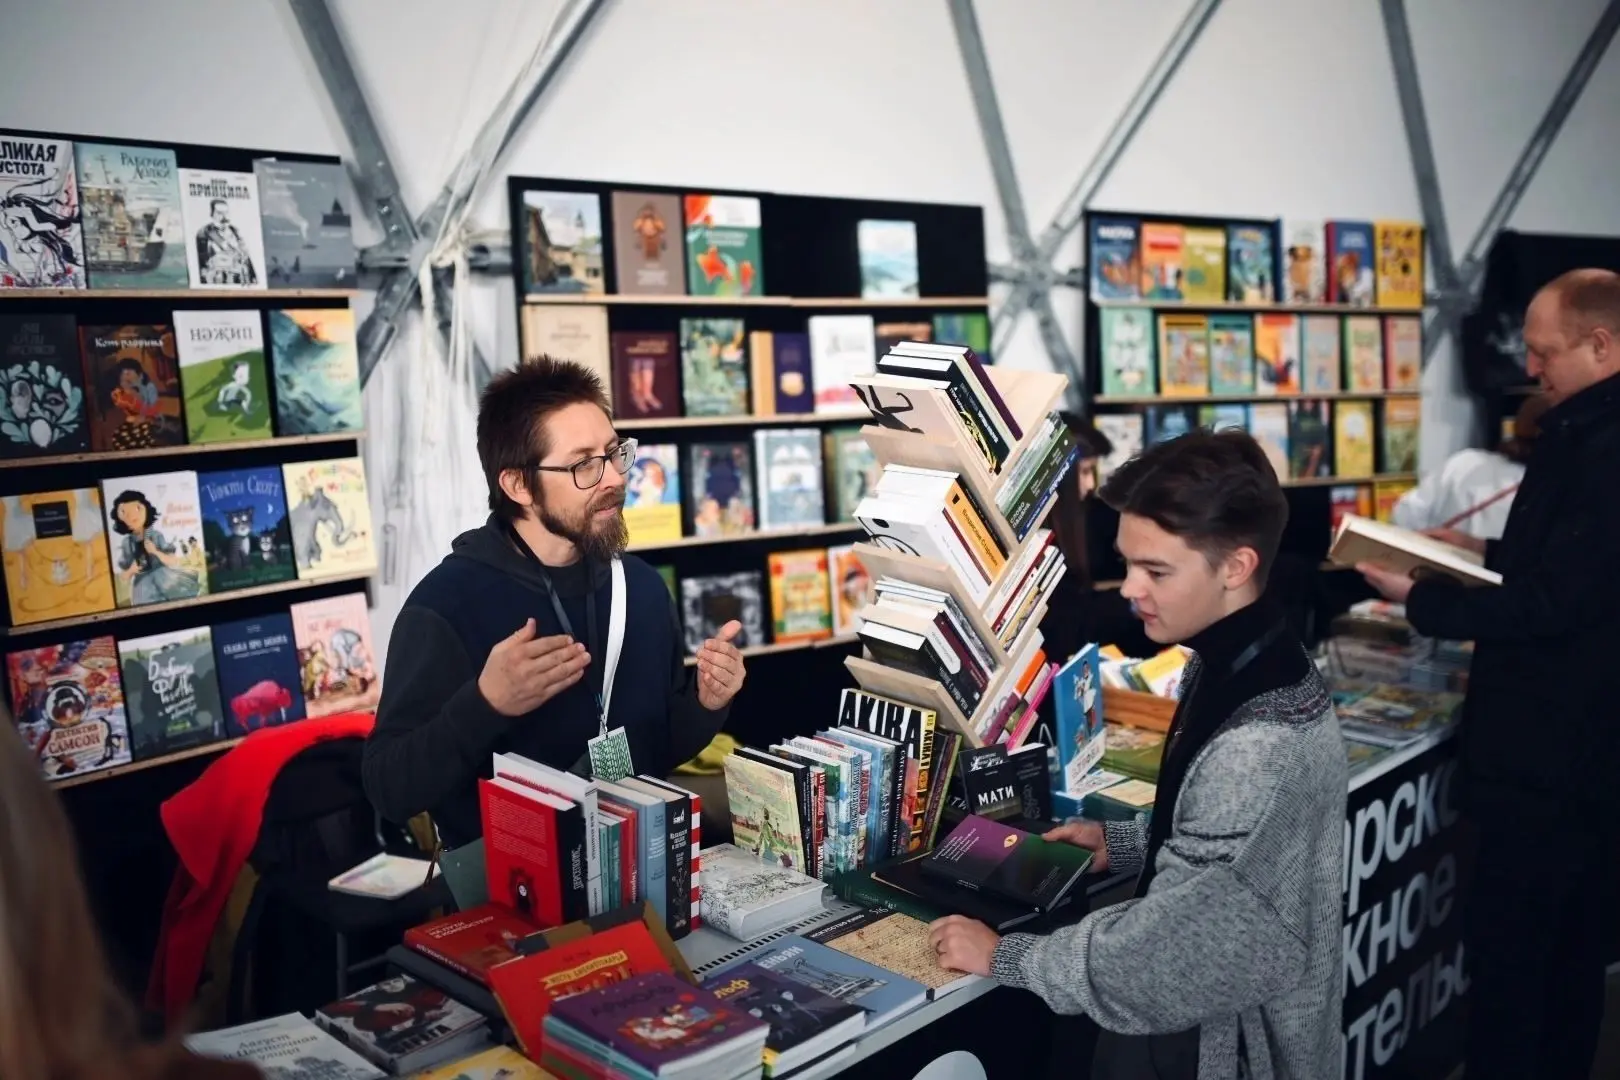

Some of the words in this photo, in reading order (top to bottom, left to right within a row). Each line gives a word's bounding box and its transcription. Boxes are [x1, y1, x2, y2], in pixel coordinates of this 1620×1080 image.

[0, 141, 57, 162] ЛИКАЯ
[0, 161, 45, 176] УСТОТА
[838, 690, 921, 759] AKIRA
[48, 735, 100, 754] САМСОН
[922, 729, 933, 757] AKIRA
[978, 785, 1014, 806] МАТИ
[757, 946, 804, 969] ЕНЬЯН
